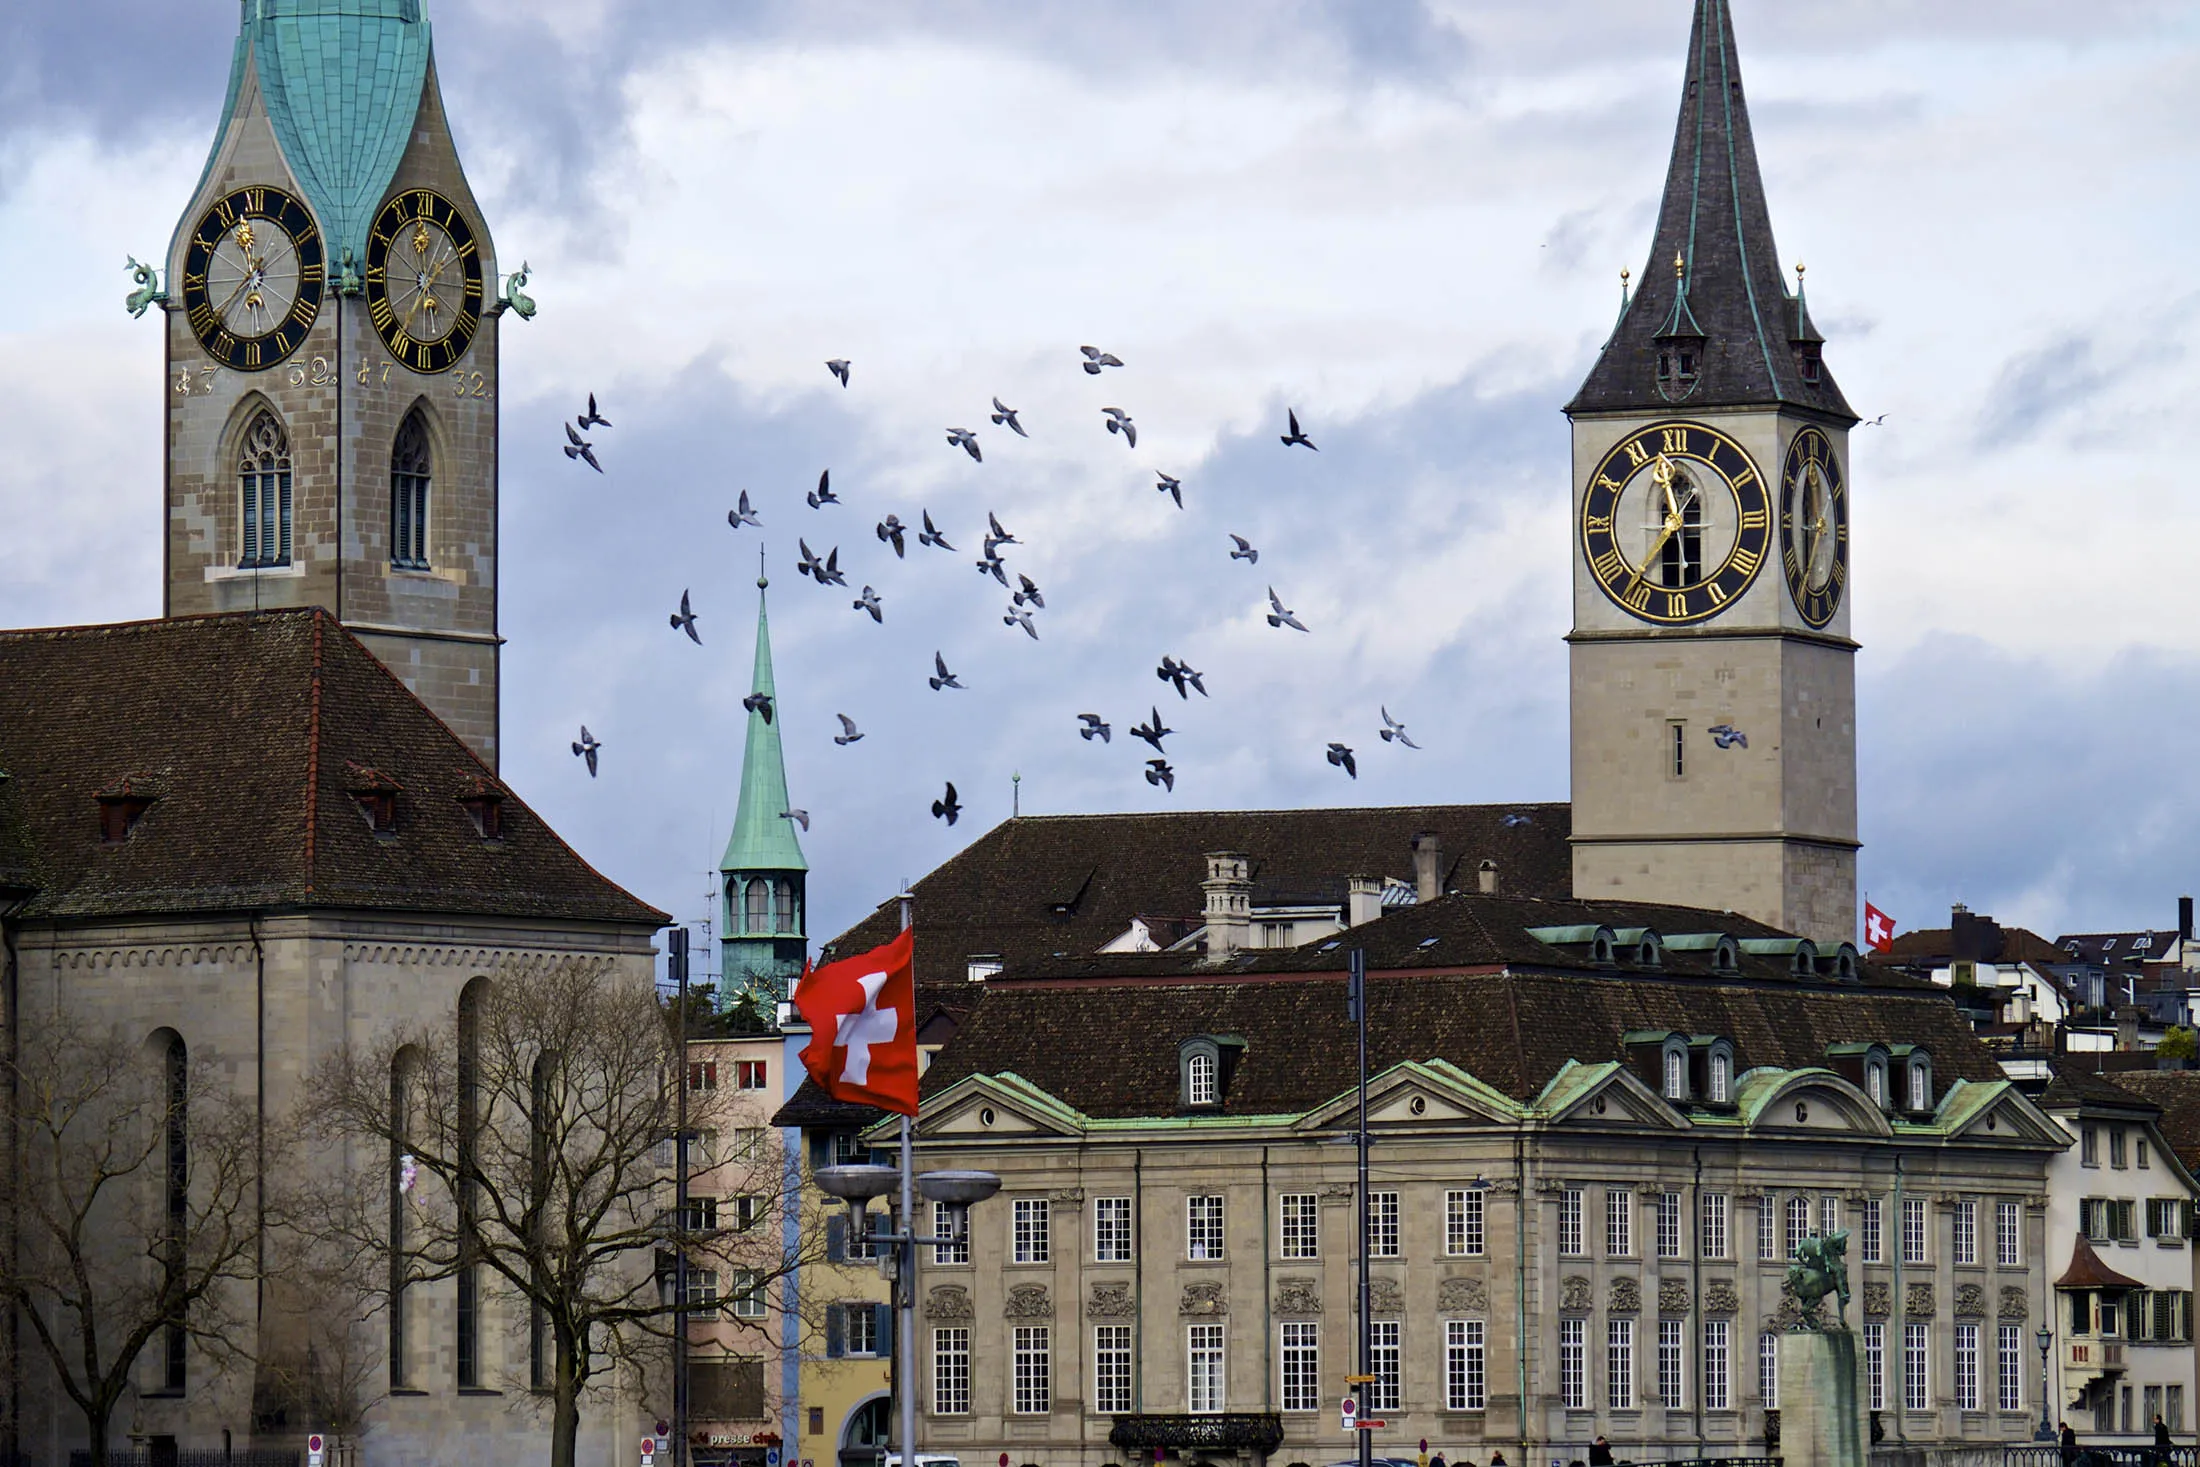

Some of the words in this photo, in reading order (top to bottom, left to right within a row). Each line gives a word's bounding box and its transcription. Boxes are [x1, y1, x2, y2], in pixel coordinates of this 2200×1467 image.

[215, 200, 235, 227] XI
[392, 198, 409, 223] XI
[417, 193, 434, 217] XII
[194, 233, 213, 253] X
[296, 225, 315, 244] II
[374, 226, 390, 246] X
[460, 240, 475, 257] II
[186, 273, 204, 291] IX
[304, 264, 322, 282] III
[368, 264, 384, 283] IX
[466, 278, 482, 297] III
[292, 297, 317, 329] IIII
[457, 310, 477, 340] IIII
[276, 332, 291, 354] V
[443, 340, 457, 363] V
[1662, 429, 1688, 453] XII
[1708, 439, 1721, 461] I
[1624, 440, 1649, 467] XI
[1598, 474, 1621, 493] X
[1732, 468, 1754, 489] II
[1588, 515, 1610, 535] IX
[1743, 509, 1766, 530] III
[1730, 547, 1759, 576] IIII
[1707, 582, 1727, 605] V
[711, 1433, 750, 1446] presse
